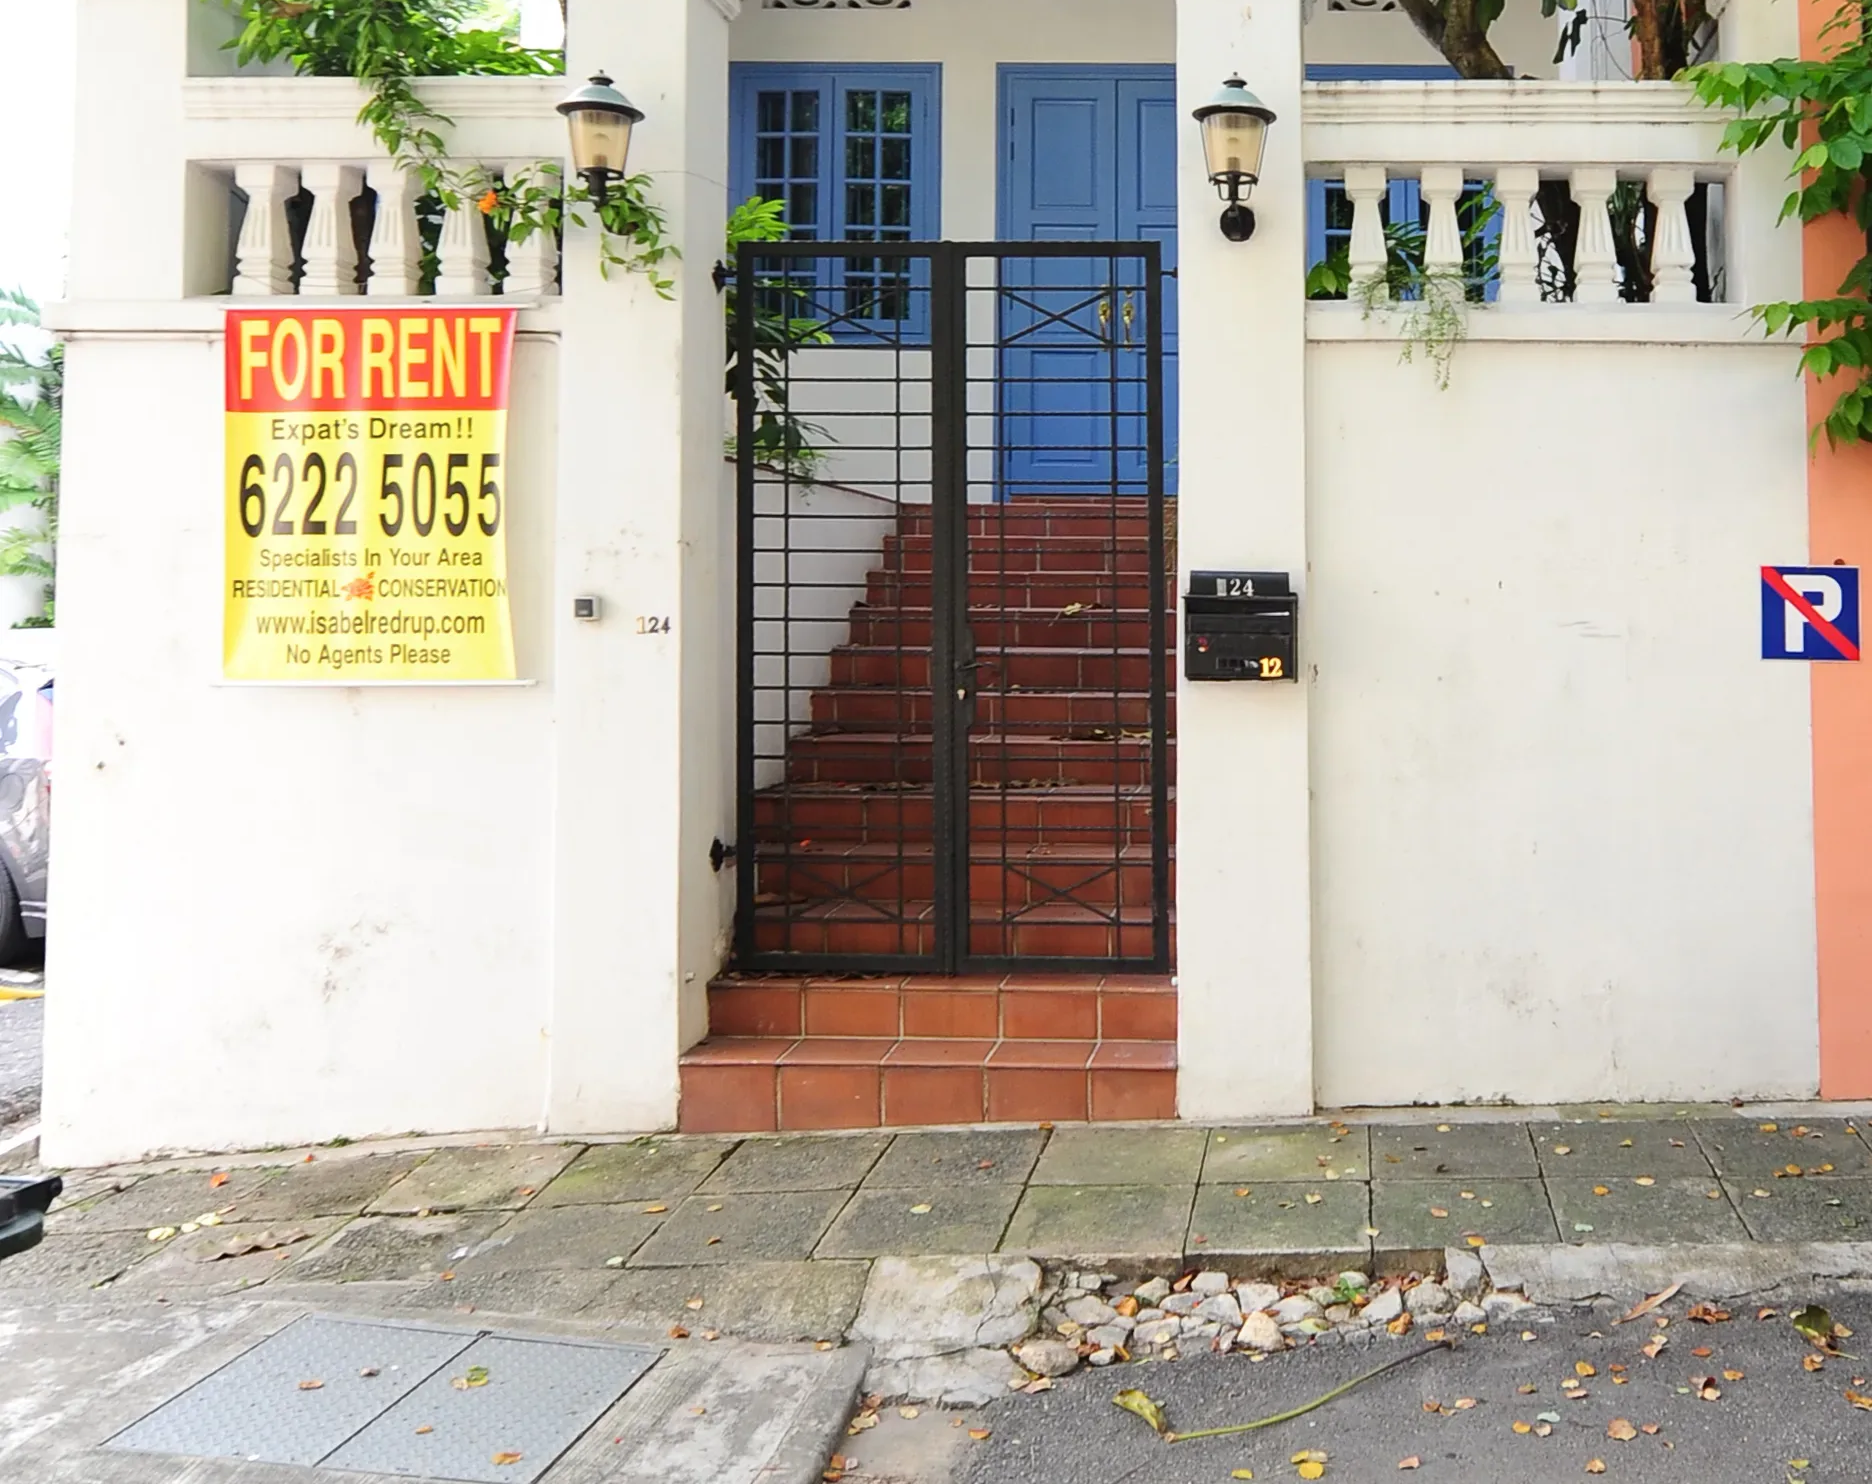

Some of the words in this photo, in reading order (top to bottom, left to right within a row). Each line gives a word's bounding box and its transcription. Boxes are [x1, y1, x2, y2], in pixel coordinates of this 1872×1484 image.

[240, 318, 346, 401] FOR
[361, 317, 501, 399] RENT
[271, 417, 360, 445] Expat's
[369, 417, 474, 439] Dream!!
[239, 452, 358, 538] 6222
[378, 452, 501, 537] 5055
[259, 548, 358, 571] Specialists
[364, 548, 381, 566] In
[389, 548, 430, 566] Your
[437, 548, 483, 566] Area
[232, 579, 340, 598] RESIDENTIAL
[377, 579, 506, 598] CONSERVATION
[1216, 578, 1255, 596] 24
[256, 610, 485, 640] www.isabelredrup.com
[636, 616, 671, 634] 124
[286, 644, 311, 664] No
[318, 644, 383, 669] Agents
[389, 643, 451, 664] Please
[1259, 657, 1284, 678] 12
